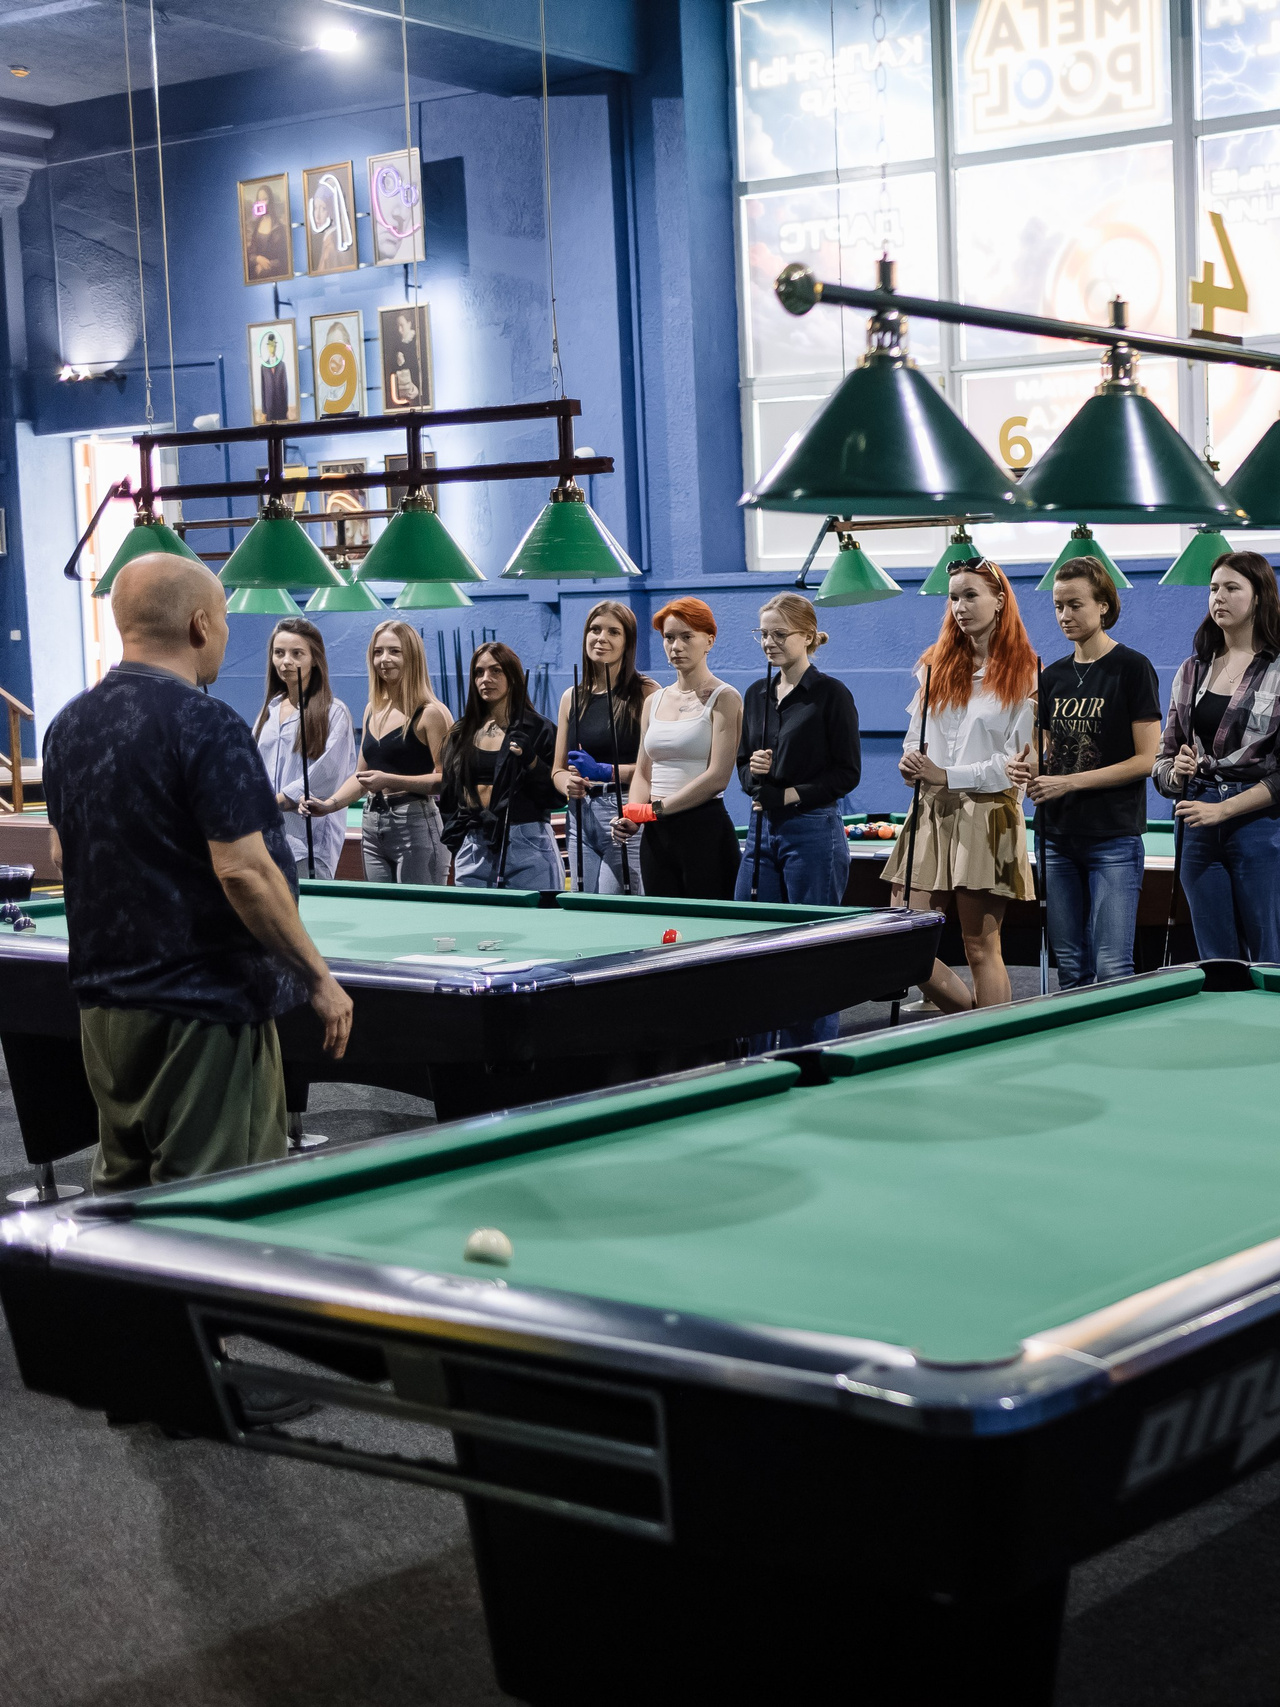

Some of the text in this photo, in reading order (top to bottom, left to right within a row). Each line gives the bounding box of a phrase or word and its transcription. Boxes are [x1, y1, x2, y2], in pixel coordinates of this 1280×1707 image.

[319, 342, 357, 414] 9
[998, 415, 1033, 468] 6
[1052, 697, 1105, 718] YOUR
